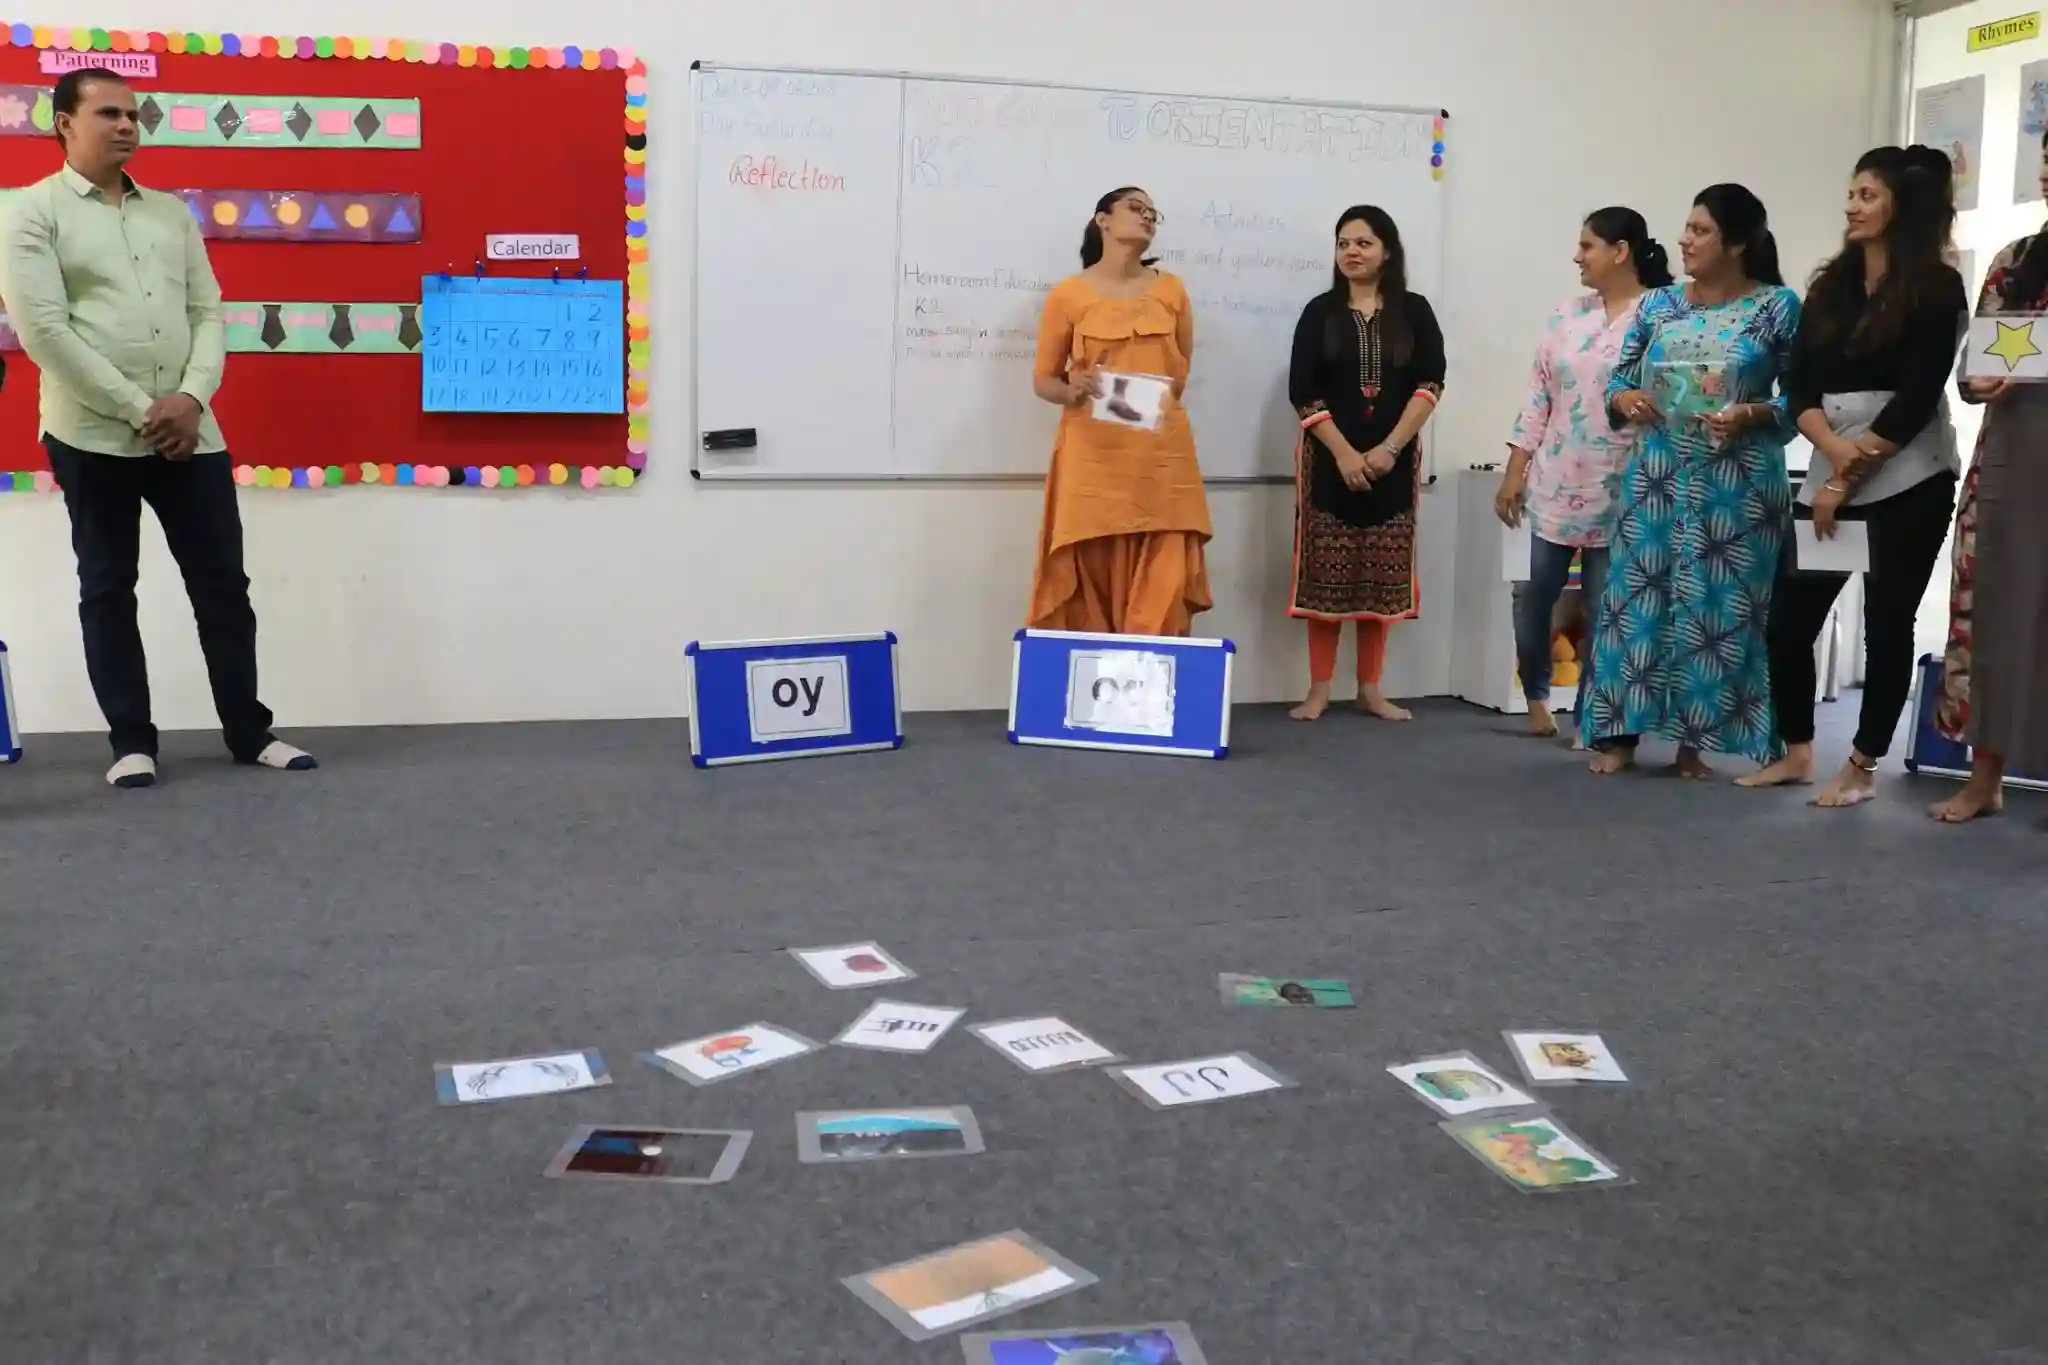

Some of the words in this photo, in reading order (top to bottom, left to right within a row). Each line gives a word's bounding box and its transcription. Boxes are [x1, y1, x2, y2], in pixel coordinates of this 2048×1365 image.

[1978, 16, 2035, 44] Rhymes
[55, 52, 149, 74] Patterning
[729, 154, 846, 194] Reflection
[493, 239, 571, 256] Calendar
[588, 302, 602, 322] 2
[429, 326, 441, 346] 3
[456, 326, 469, 345] 4
[484, 328, 500, 348] 5
[508, 328, 520, 347] 6
[535, 328, 551, 347] 7
[431, 356, 447, 373] 10
[481, 358, 497, 378] 12
[587, 360, 602, 377] 16
[771, 675, 825, 716] oy
